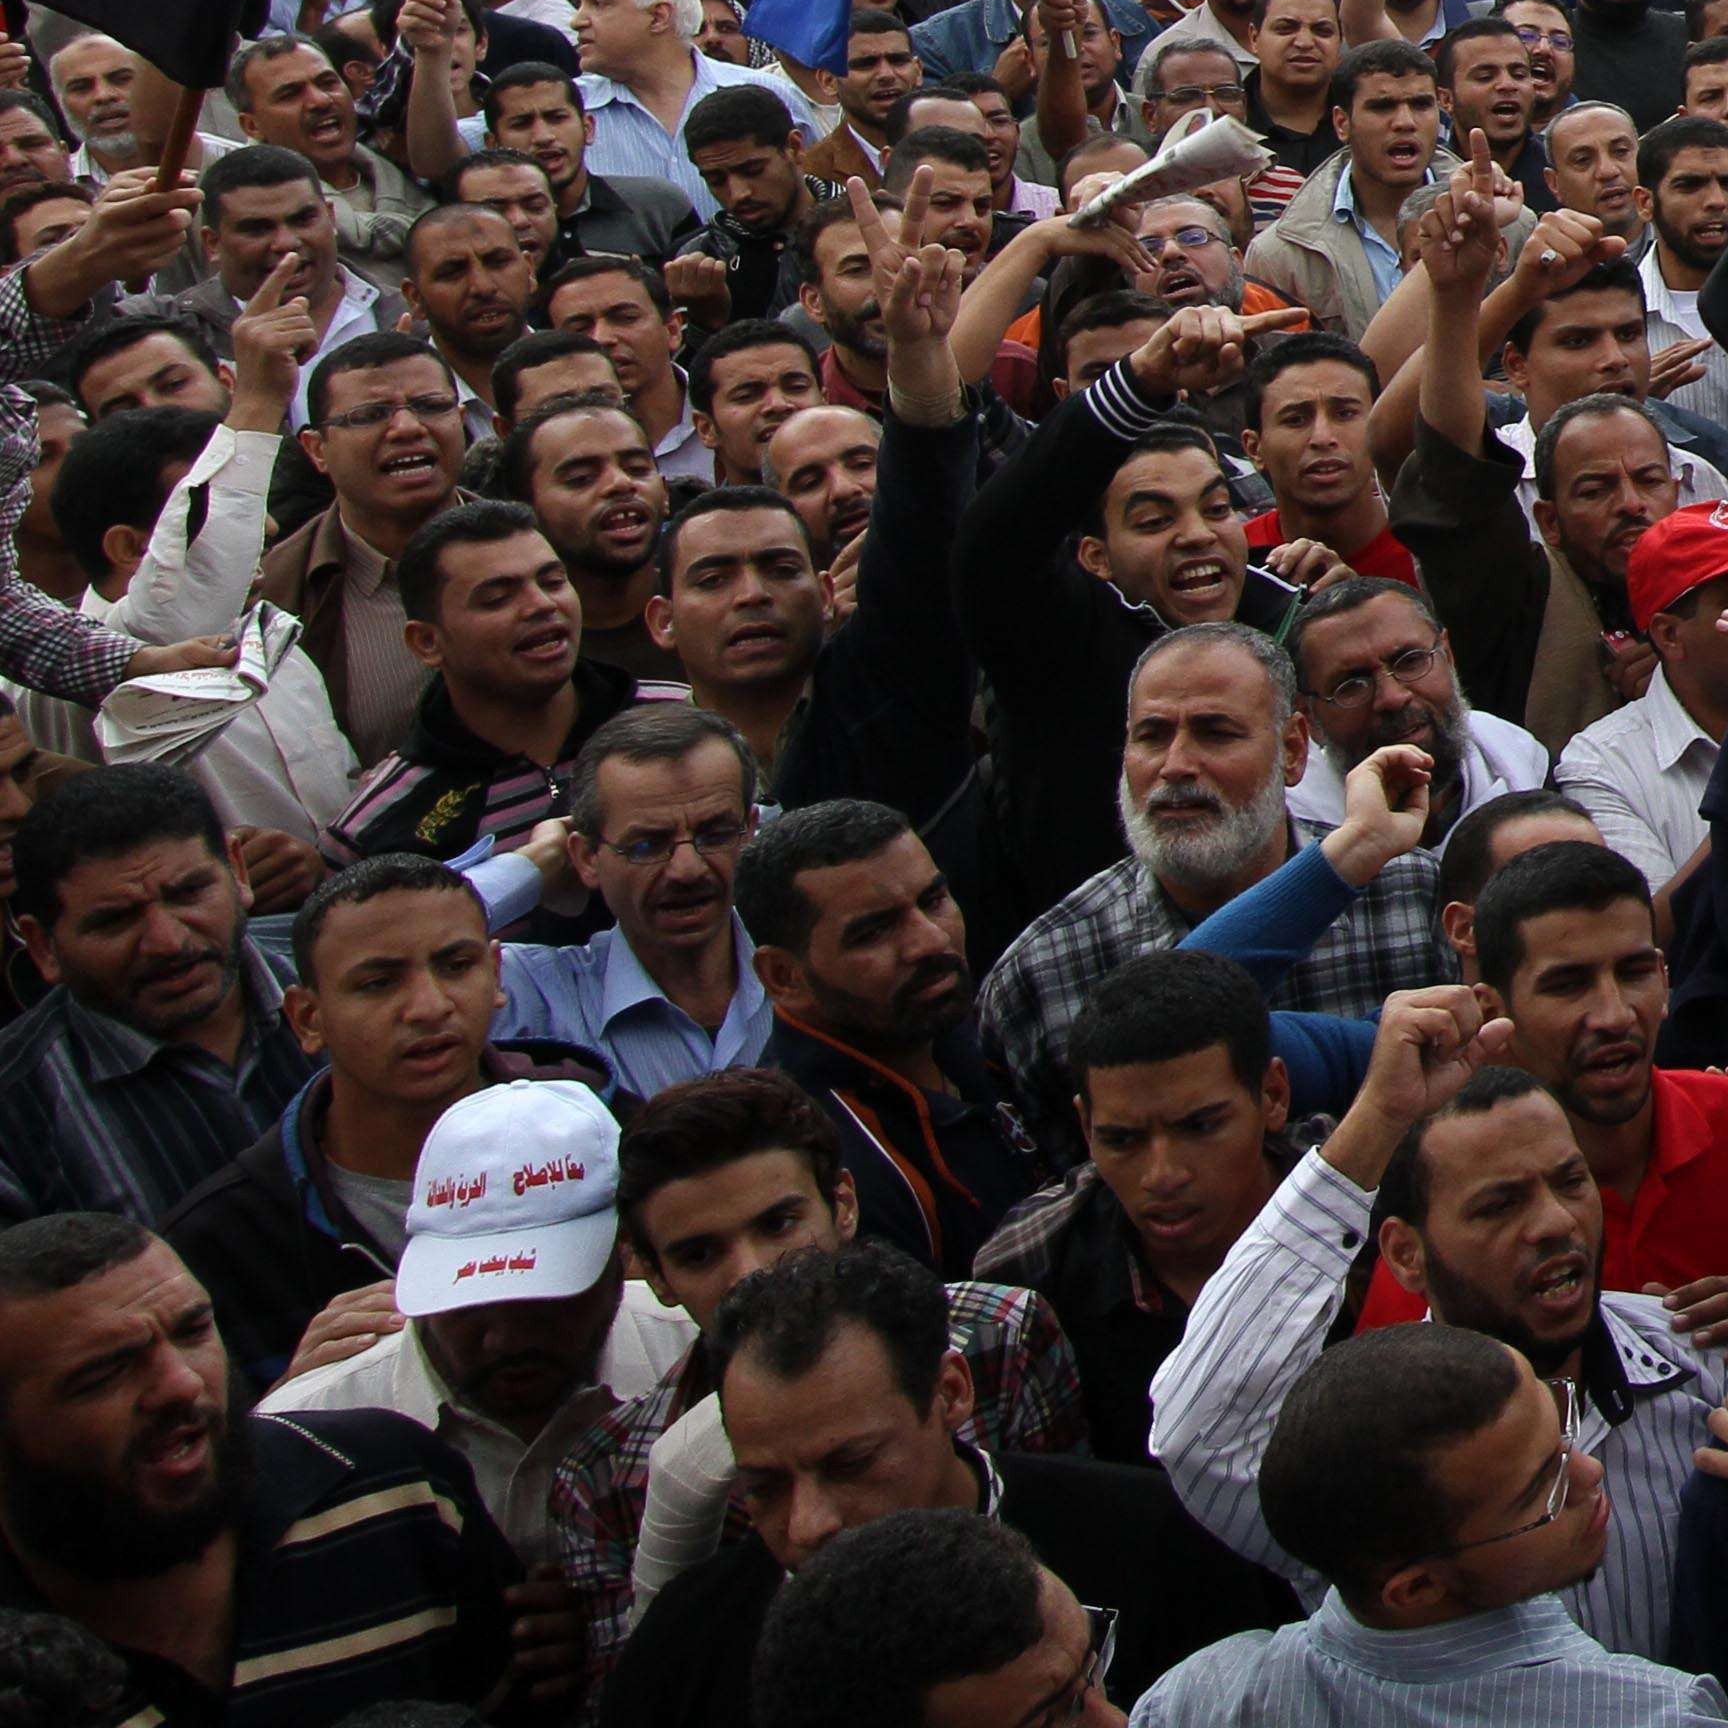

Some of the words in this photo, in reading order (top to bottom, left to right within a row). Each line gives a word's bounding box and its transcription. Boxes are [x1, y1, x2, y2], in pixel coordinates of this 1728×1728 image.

[457, 1171, 487, 1207] الحرية
[512, 1158, 562, 1196] للإصلاح
[452, 1258, 478, 1286] مصر
